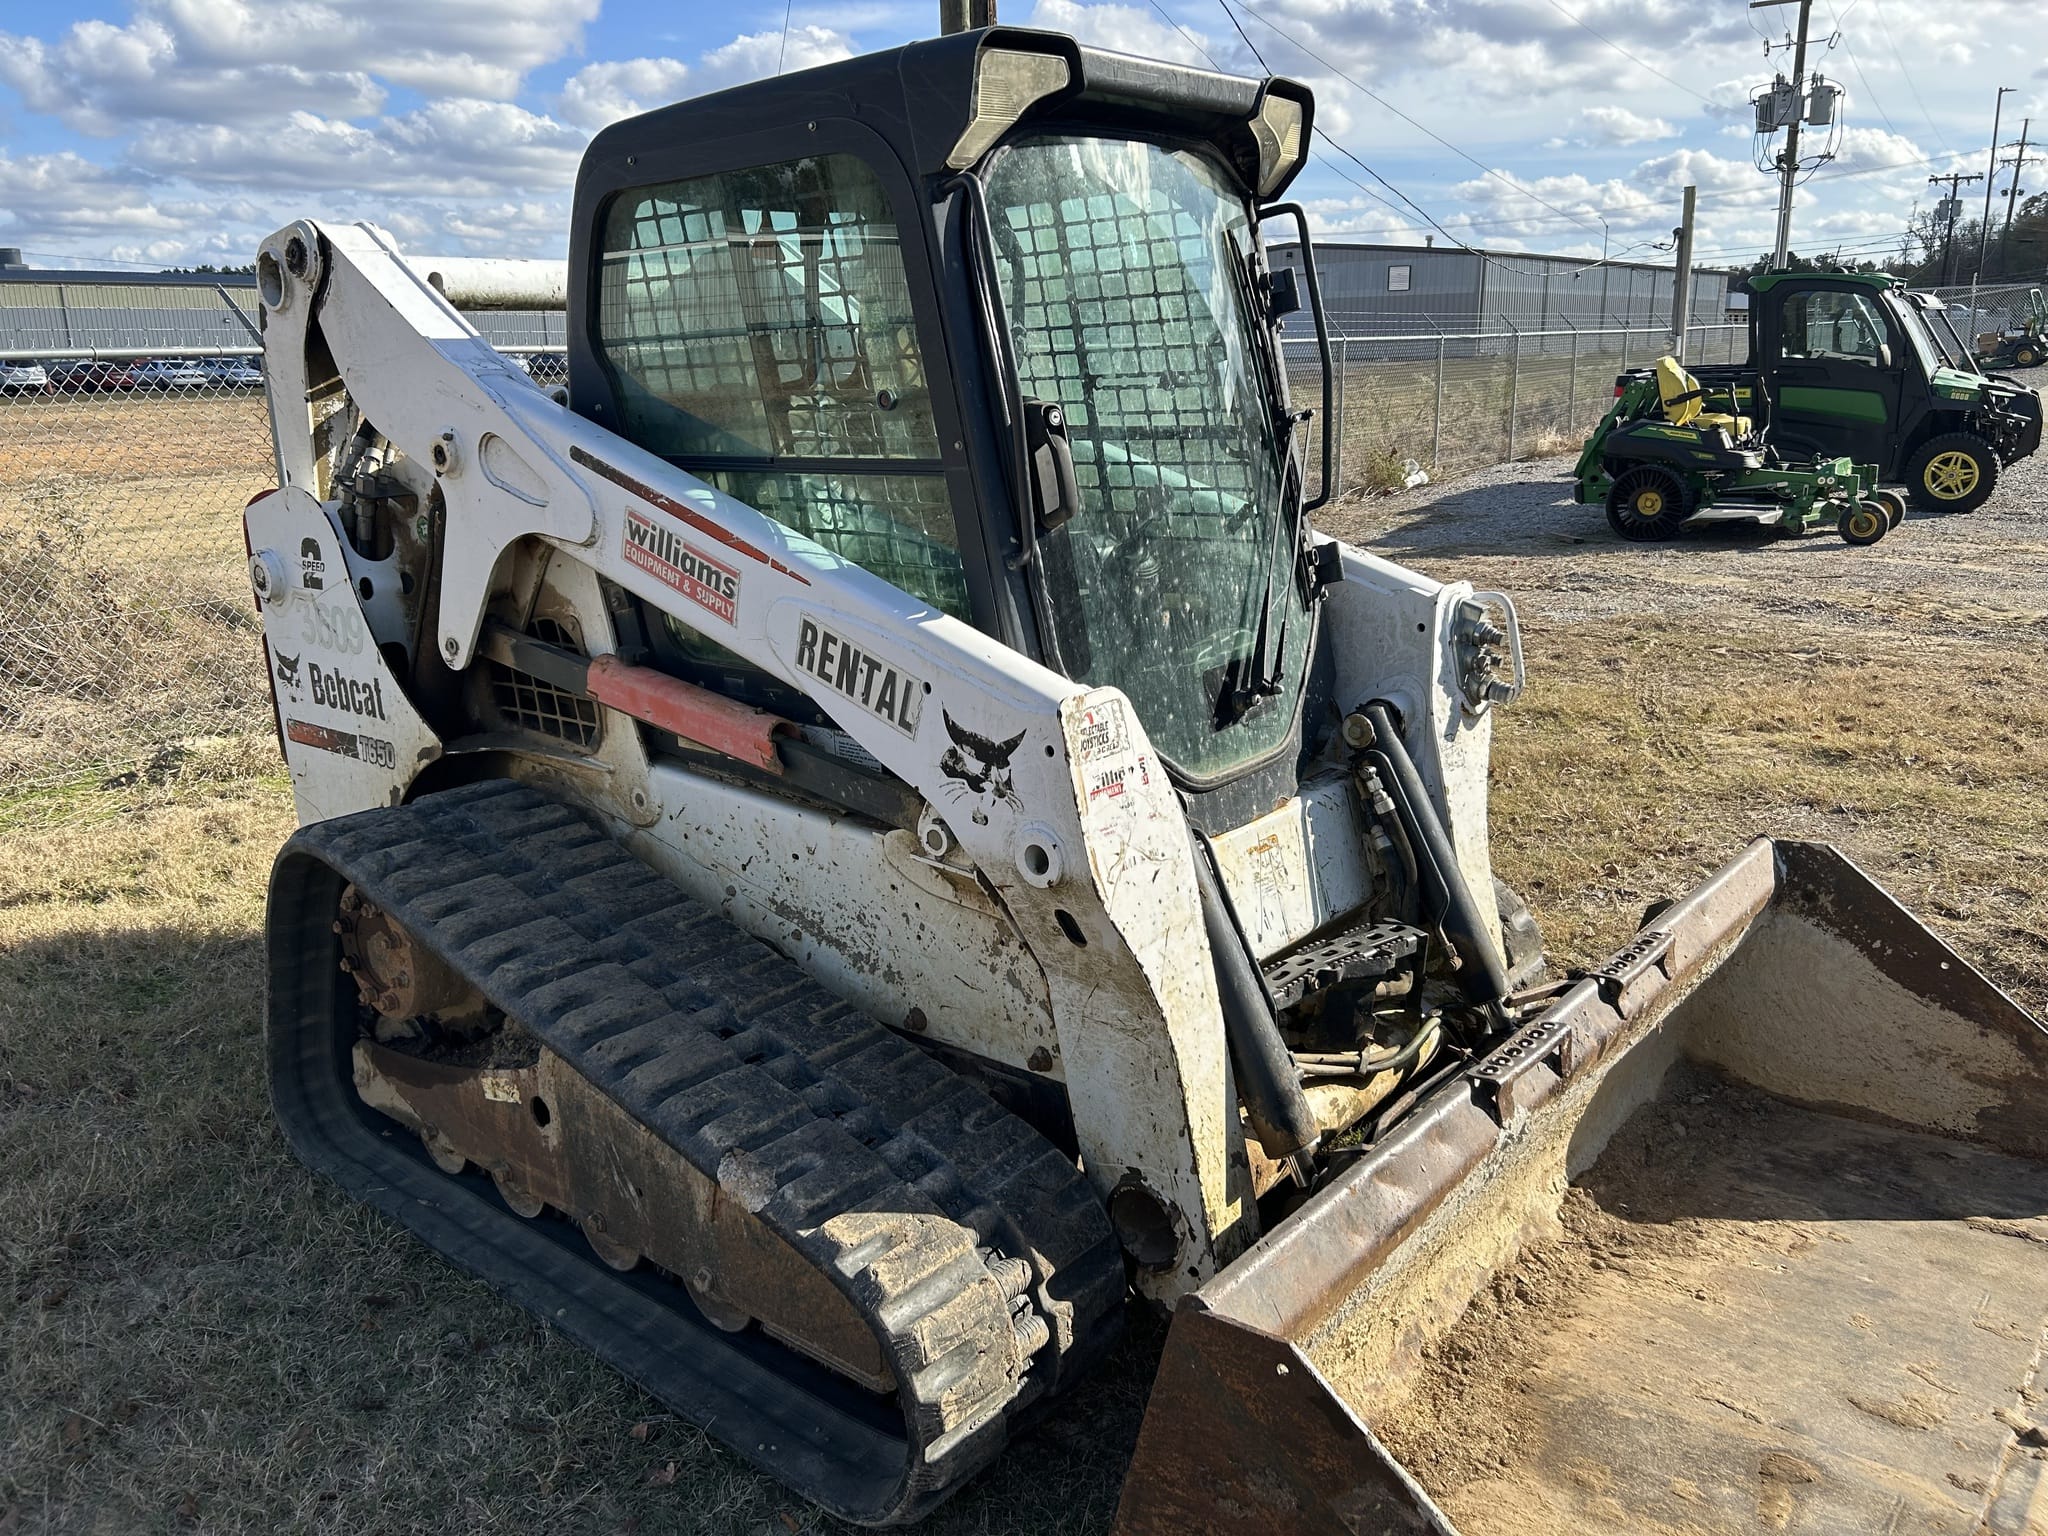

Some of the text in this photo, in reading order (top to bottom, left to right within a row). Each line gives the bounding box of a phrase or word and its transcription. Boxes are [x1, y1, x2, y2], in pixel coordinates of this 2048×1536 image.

[302, 560, 325, 572] SPEED
[625, 544, 734, 618] EQUIPMENT & SUPPLY
[628, 520, 737, 599] williams
[308, 663, 385, 720] Bobcat
[798, 619, 914, 734] RENTAL
[359, 735, 396, 770] T650
